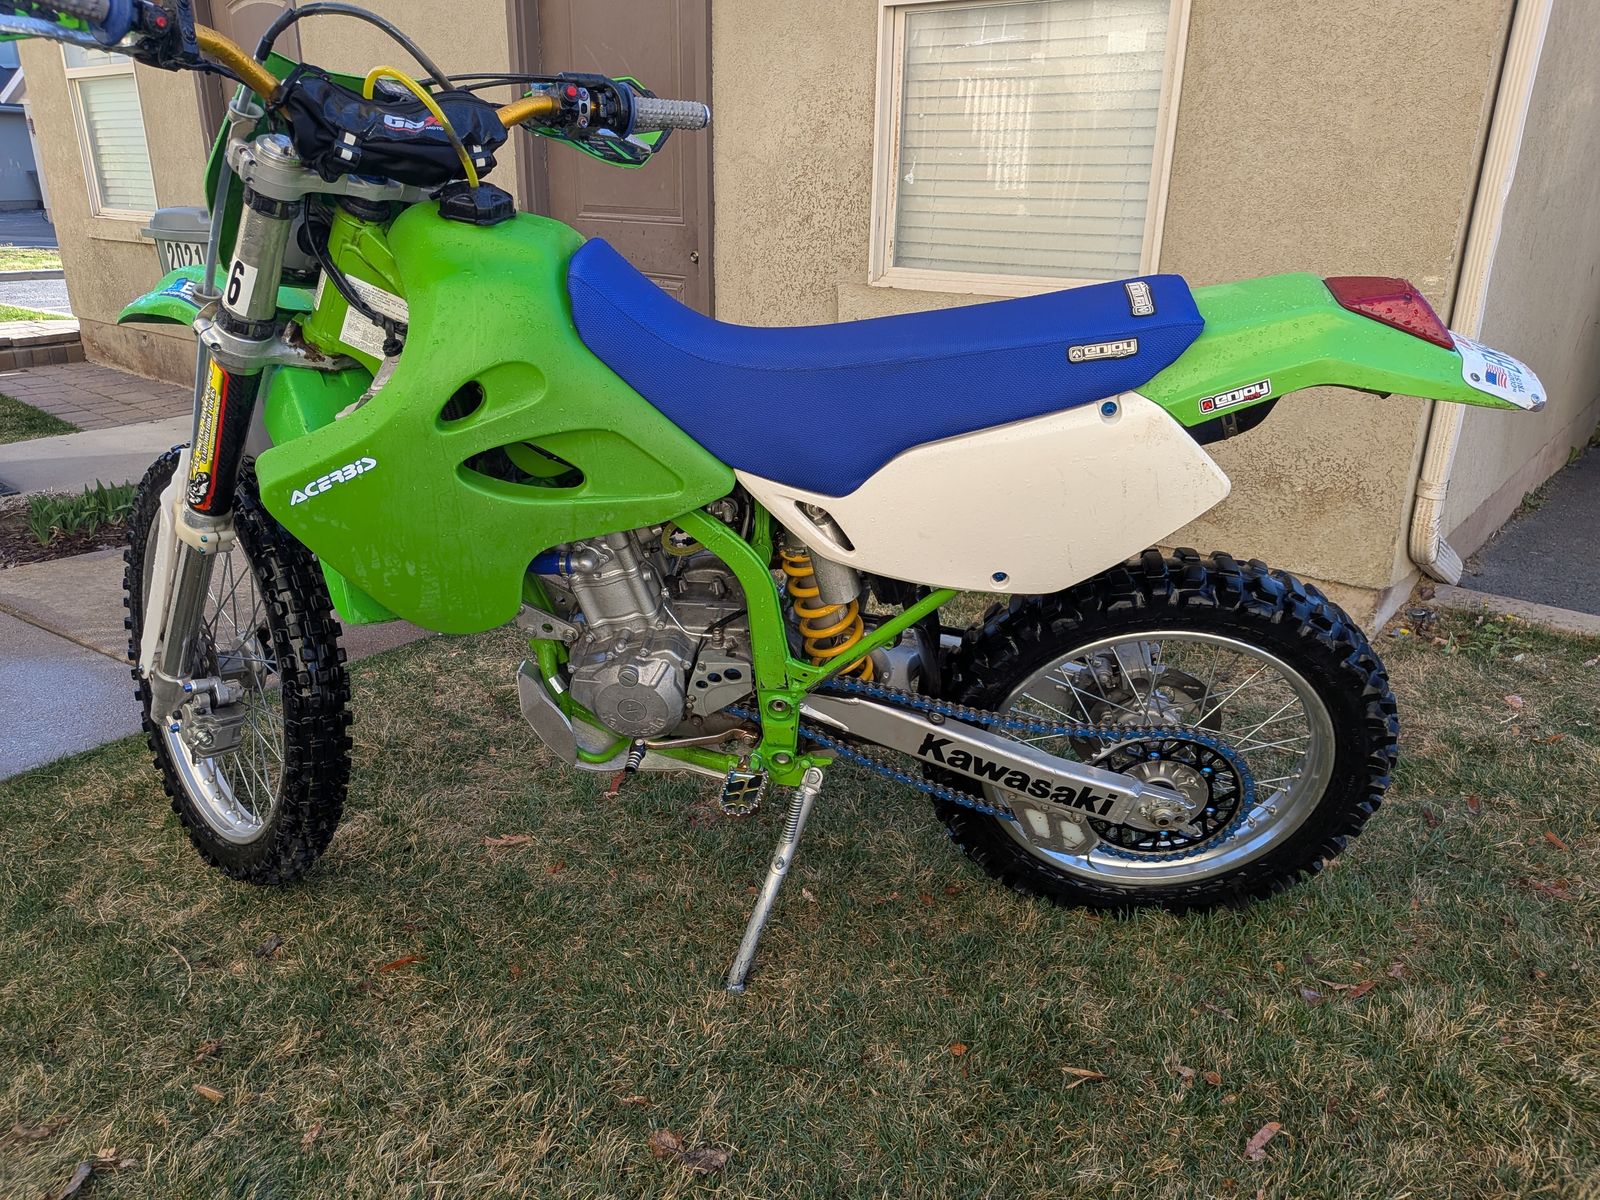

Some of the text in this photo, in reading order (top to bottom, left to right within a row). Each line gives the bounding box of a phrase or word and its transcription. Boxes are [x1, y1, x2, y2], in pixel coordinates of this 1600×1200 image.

[228, 260, 244, 305] 6
[1083, 341, 1135, 358] enjoy
[1215, 382, 1269, 407] enjoy
[917, 732, 1118, 817] Kawasaki
